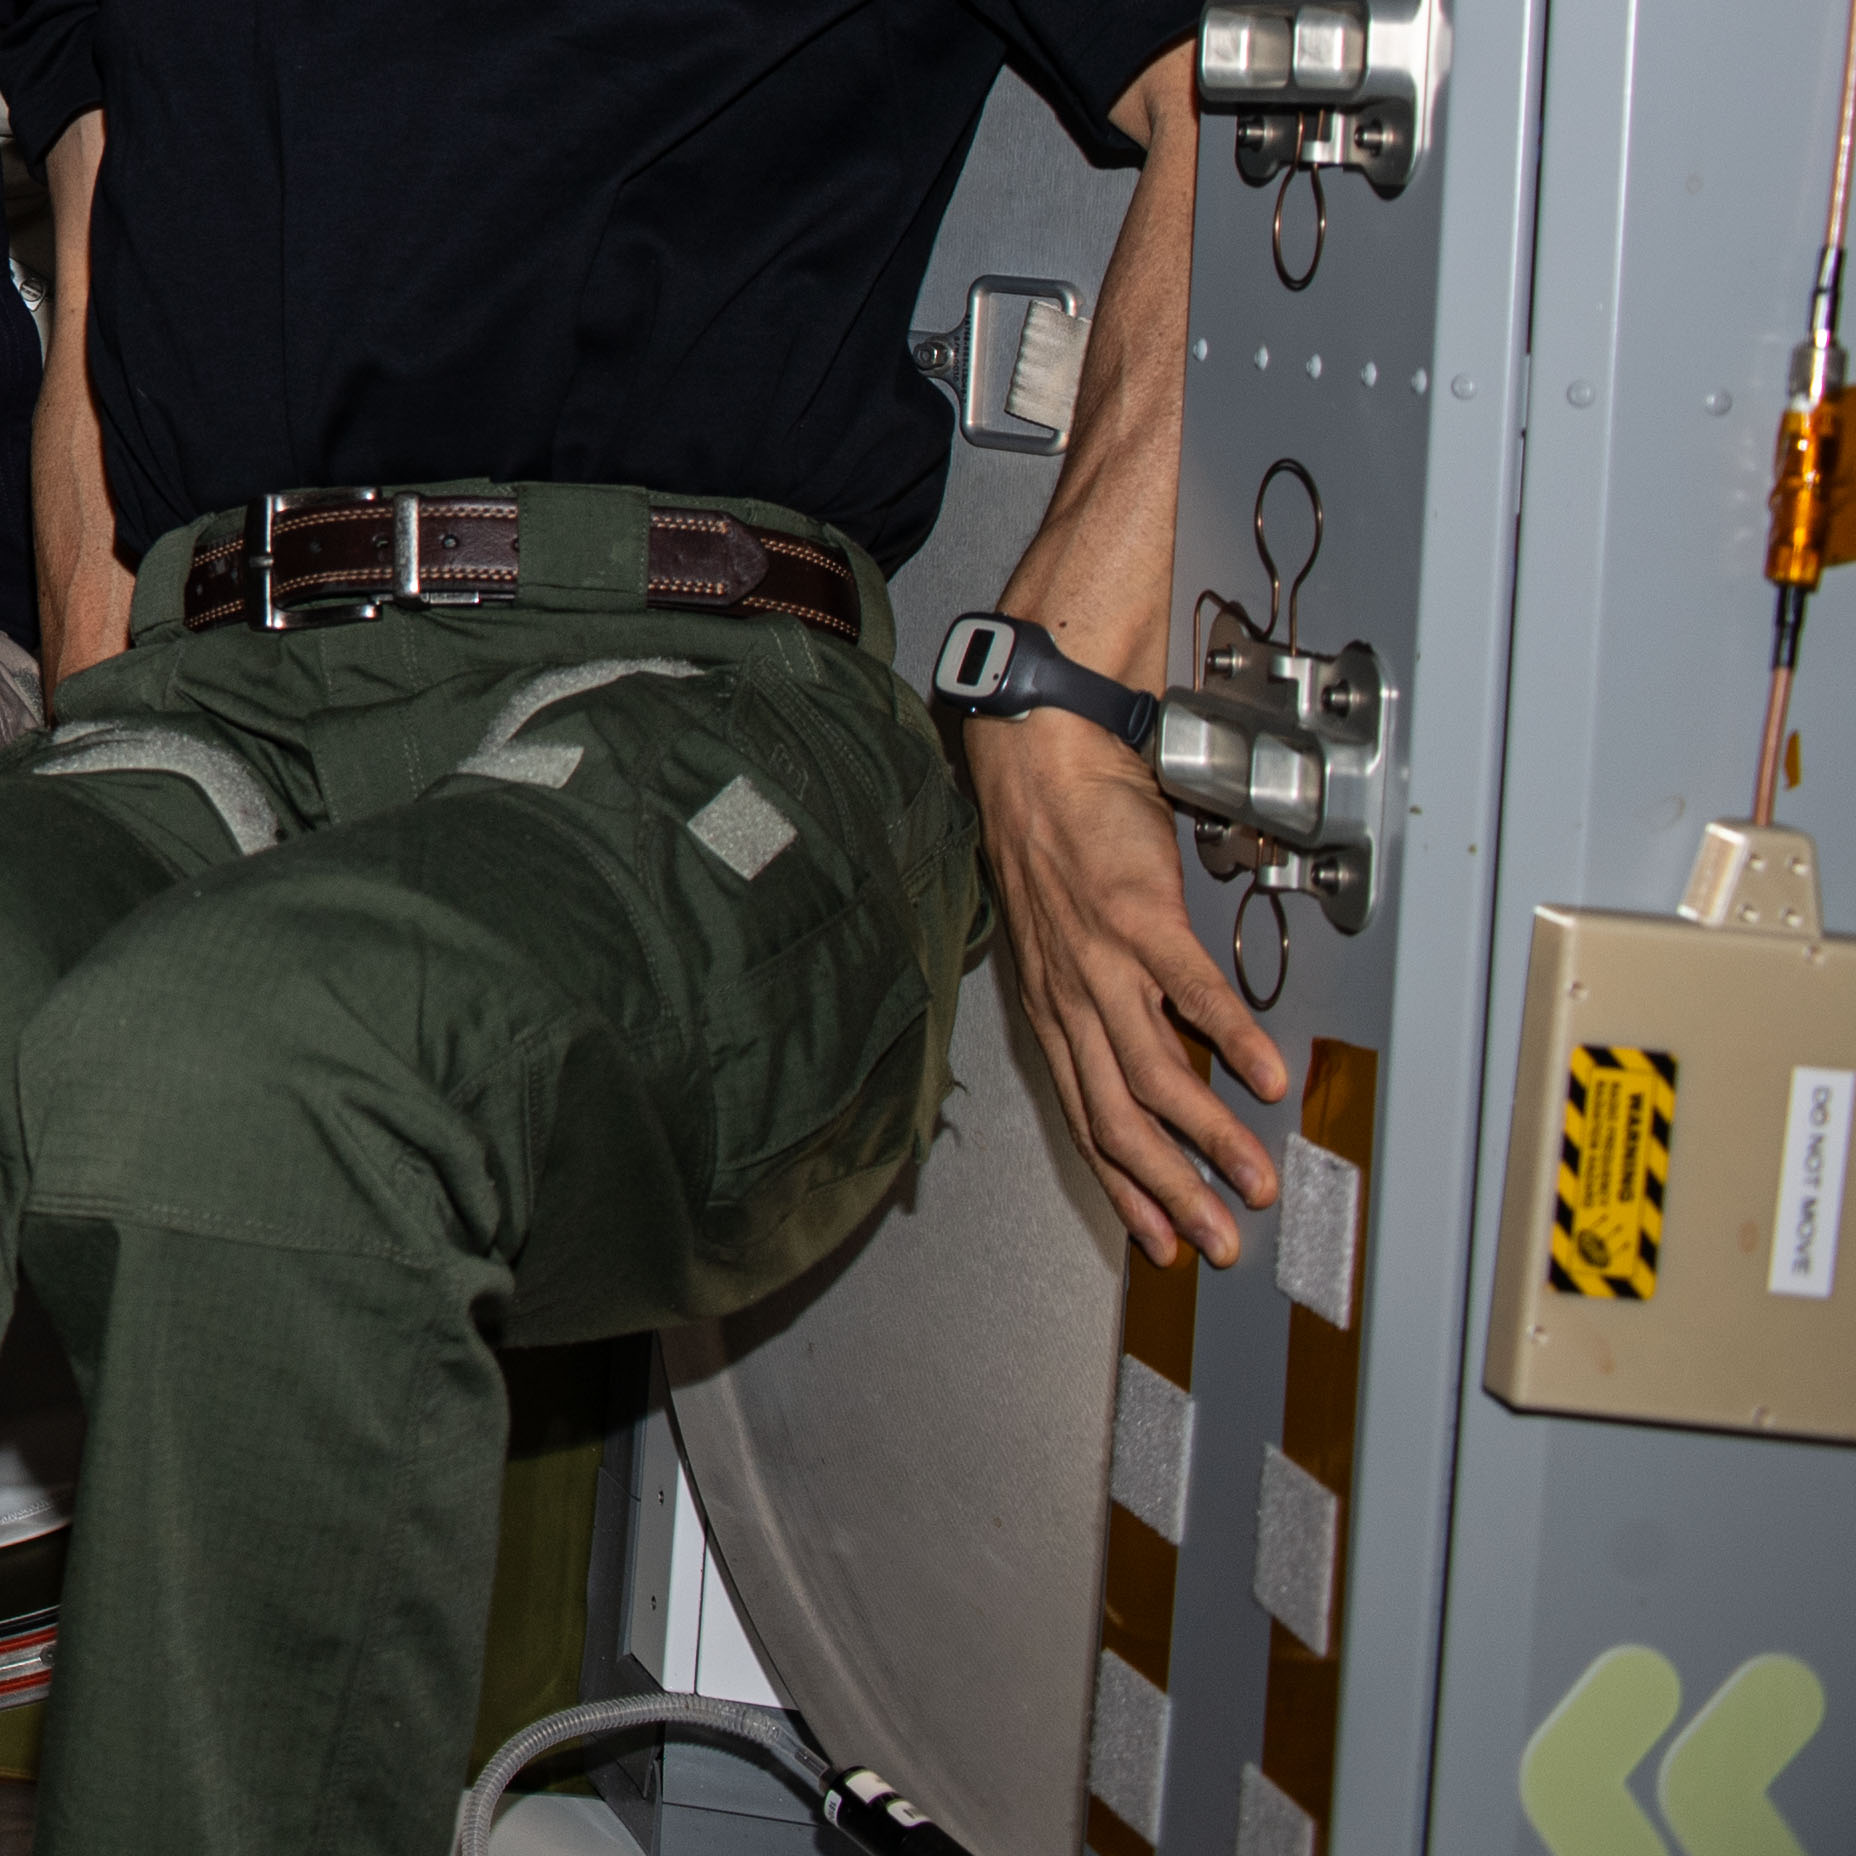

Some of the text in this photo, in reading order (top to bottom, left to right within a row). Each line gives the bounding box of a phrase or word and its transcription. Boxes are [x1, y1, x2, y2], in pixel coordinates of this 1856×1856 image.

[1619, 1092, 1645, 1204] WARNING
[1791, 1085, 1832, 1276] DO NOT MOVE
